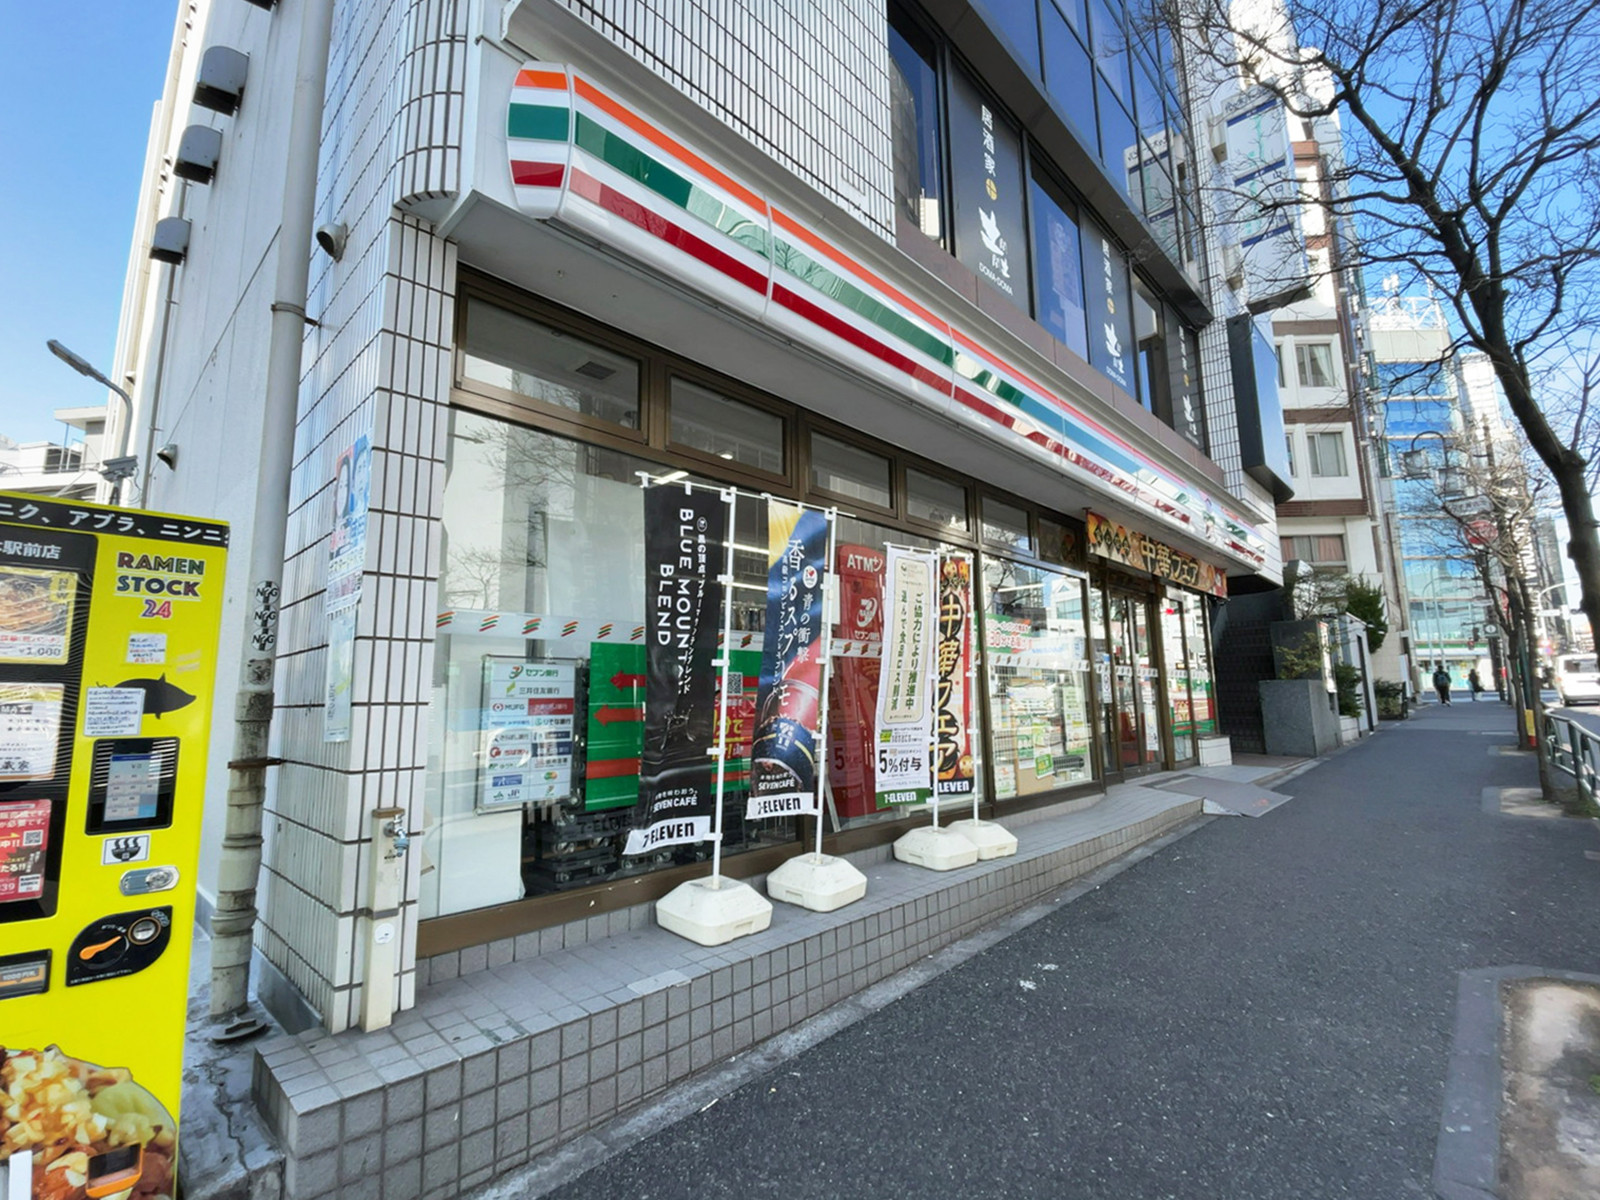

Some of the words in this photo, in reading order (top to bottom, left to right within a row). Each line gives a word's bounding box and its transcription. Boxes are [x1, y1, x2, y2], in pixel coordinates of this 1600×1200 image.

[0, 539, 62, 560] 駅前店
[679, 507, 694, 570] BLUE
[117, 551, 206, 575] RAMEN
[847, 554, 874, 571] ATM
[1139, 538, 1199, 585] 中華フェア
[116, 575, 201, 597] STOCK
[140, 599, 173, 619] 24
[656, 563, 675, 645] BLEND
[525, 668, 559, 678] セブン銀行
[930, 593, 961, 775] 中華フェア
[878, 748, 922, 774] 5%付与
[673, 793, 698, 807] CAFÉ
